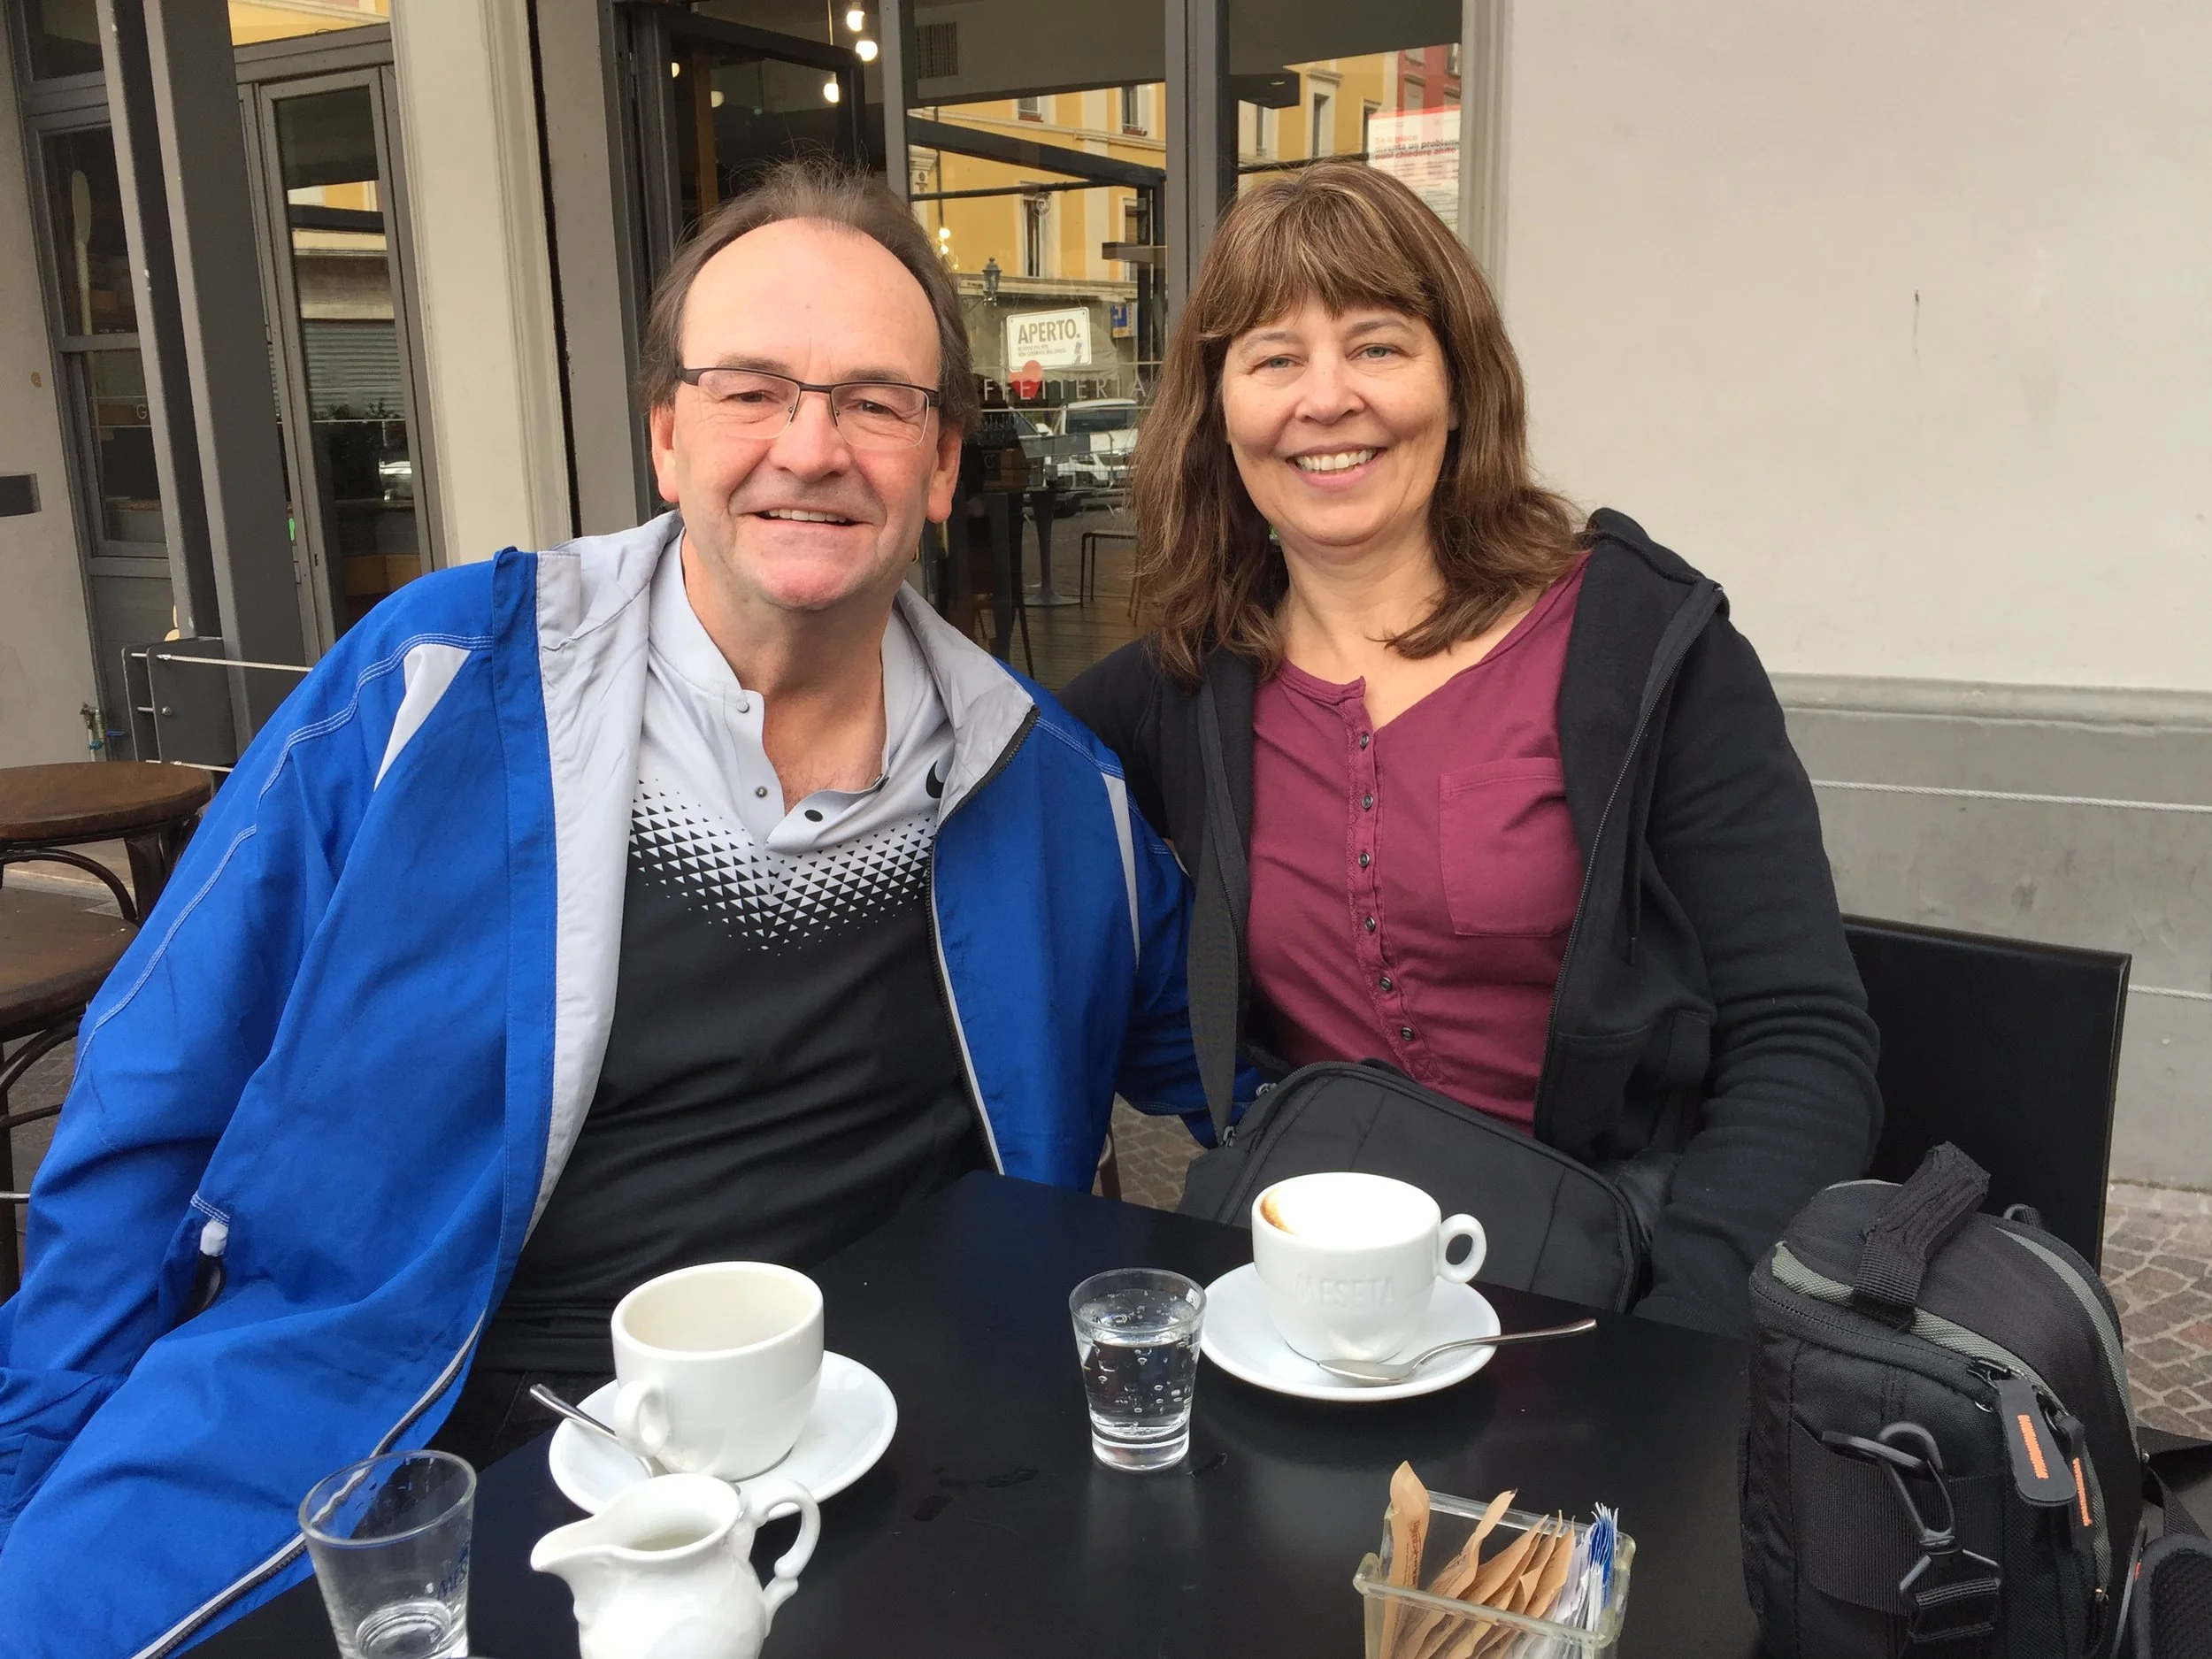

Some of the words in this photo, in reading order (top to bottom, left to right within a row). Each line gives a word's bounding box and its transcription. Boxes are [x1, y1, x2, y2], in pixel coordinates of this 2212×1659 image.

[1395, 149, 1432, 158] chiedere
[1018, 319, 1080, 344] APERTO.
[1292, 1271, 1396, 1309] MESETA
